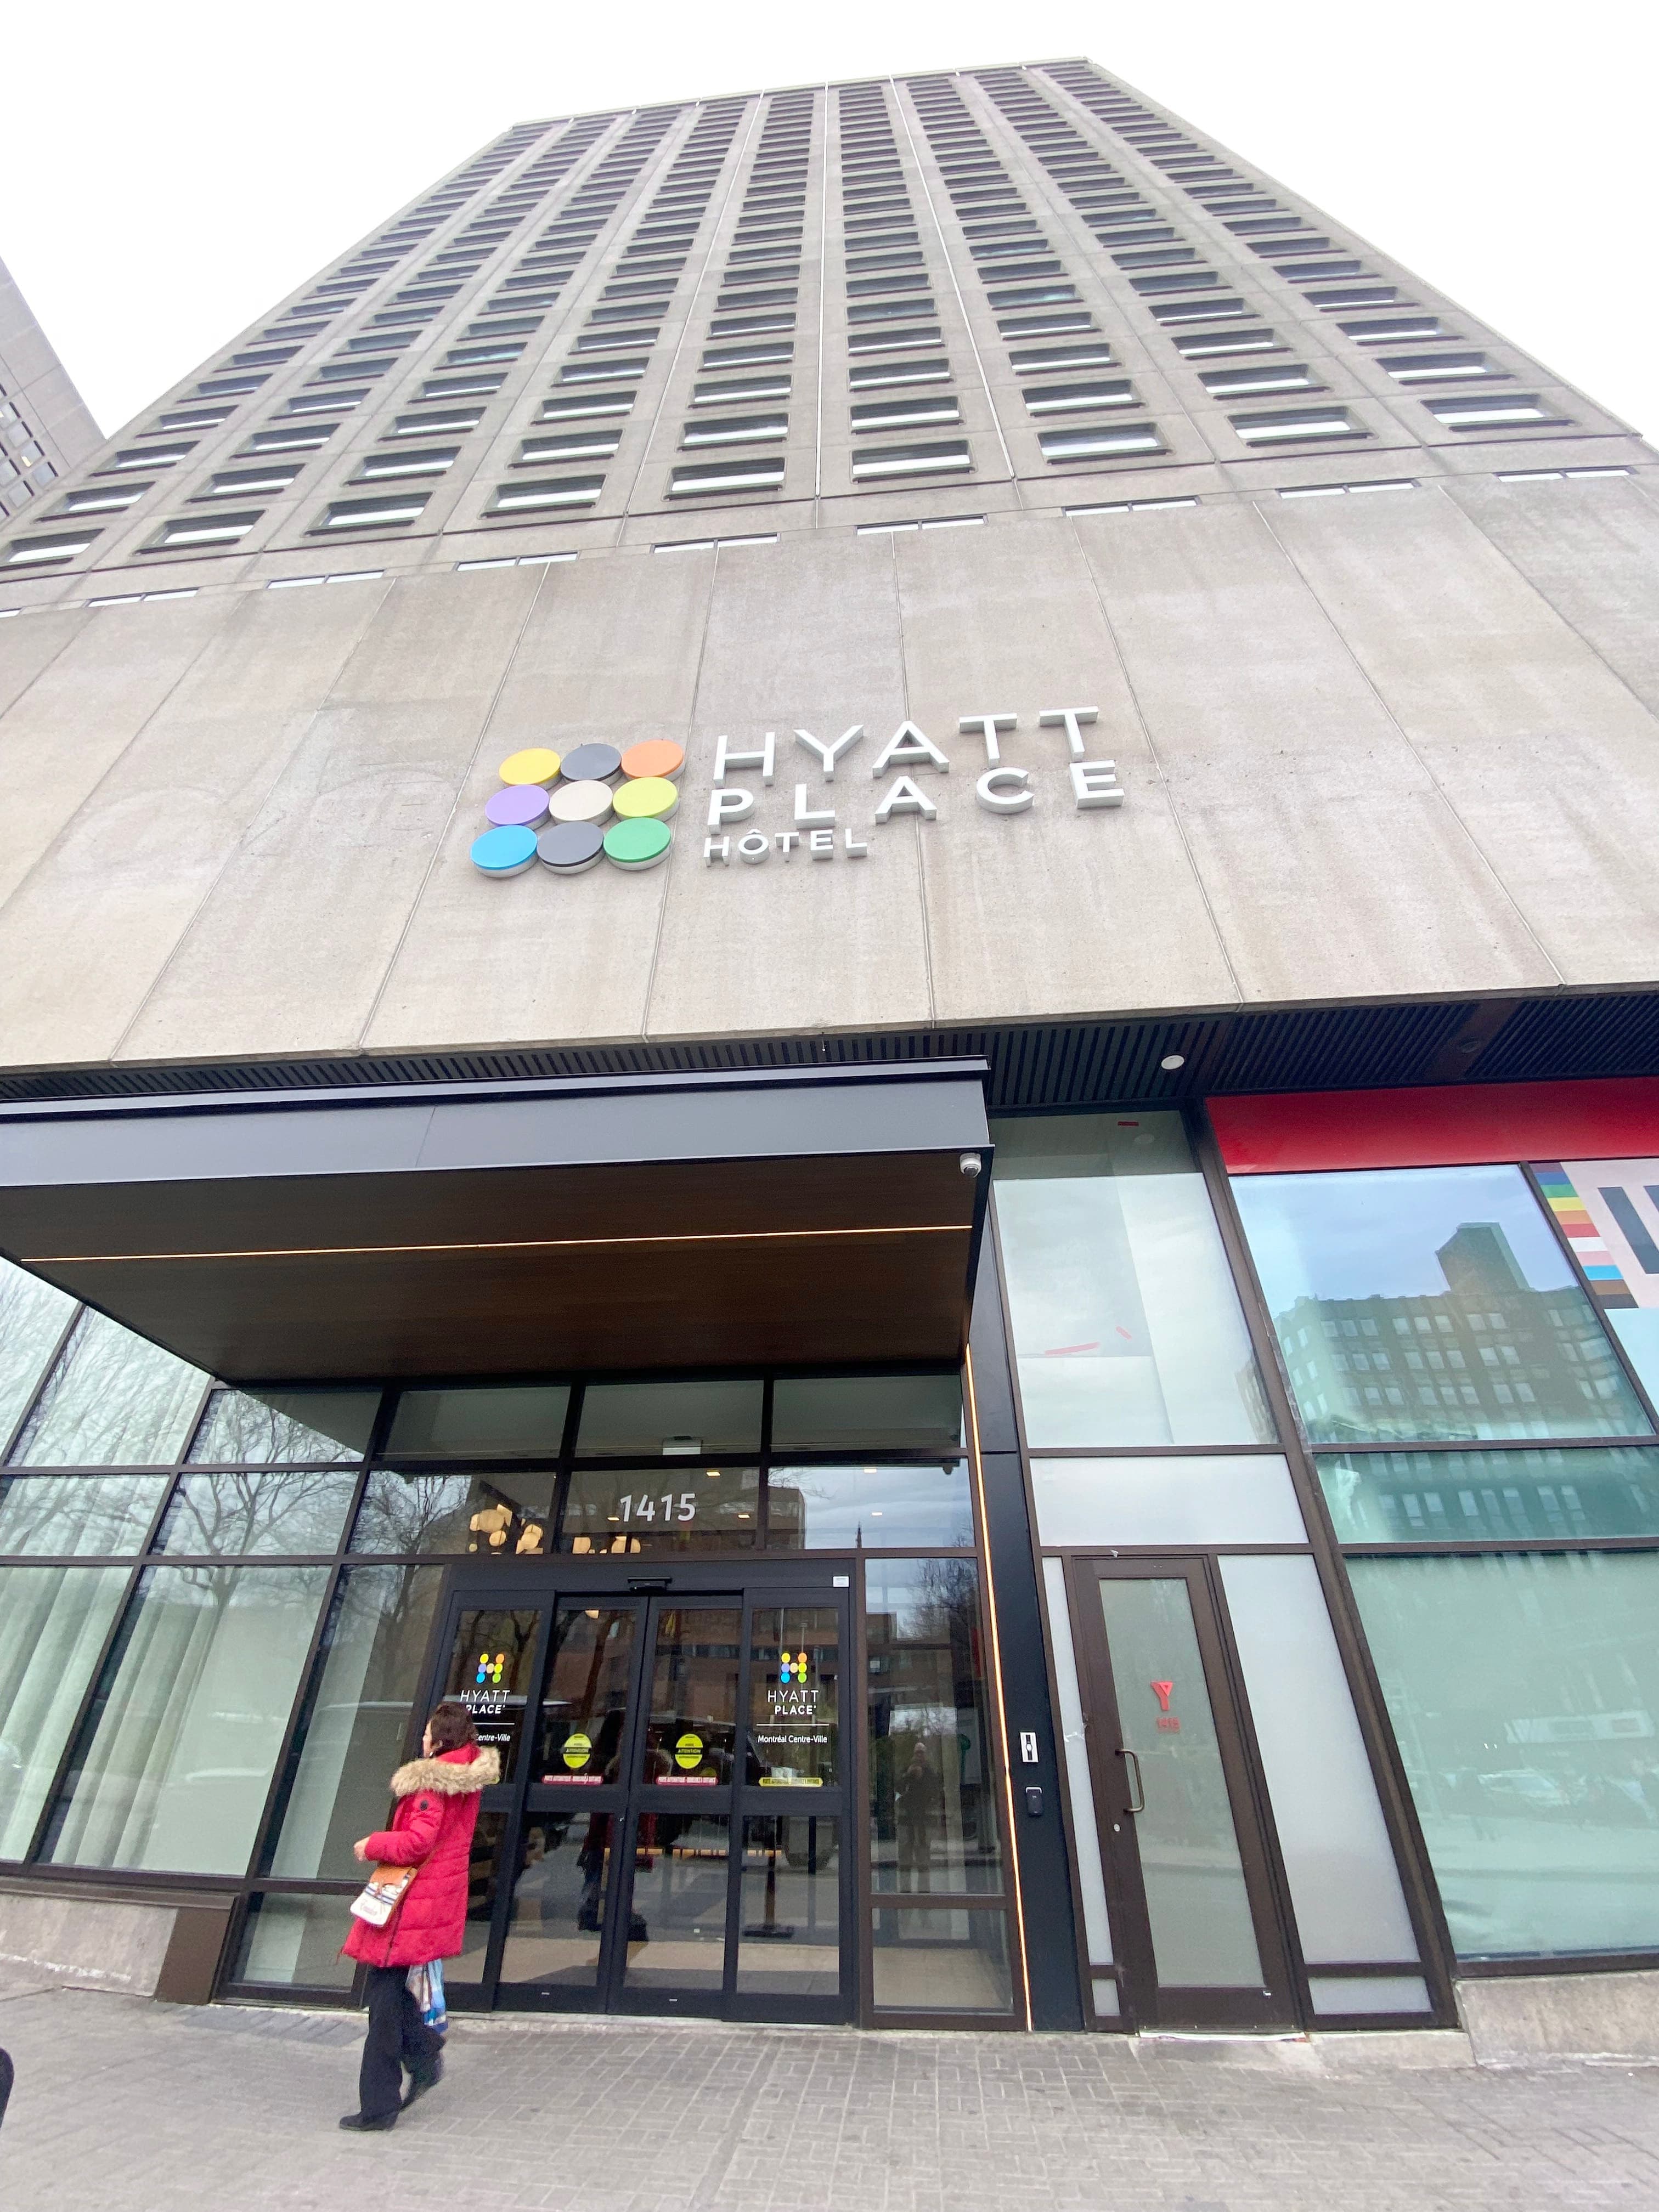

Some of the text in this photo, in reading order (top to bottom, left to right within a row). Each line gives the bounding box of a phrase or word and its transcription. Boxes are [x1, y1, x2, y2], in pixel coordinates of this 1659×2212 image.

[713, 706, 1099, 789] HYATT
[707, 760, 1125, 835] PLACE
[703, 828, 868, 867] HÔTEL
[620, 1492, 696, 1522] 1415
[460, 1690, 510, 1702] HYATT
[768, 1690, 819, 1703] HYATT
[775, 1705, 813, 1715] PLACE
[476, 1734, 511, 1742] entre-Ville
[758, 1735, 827, 1743] Montréal Centre-Ville
